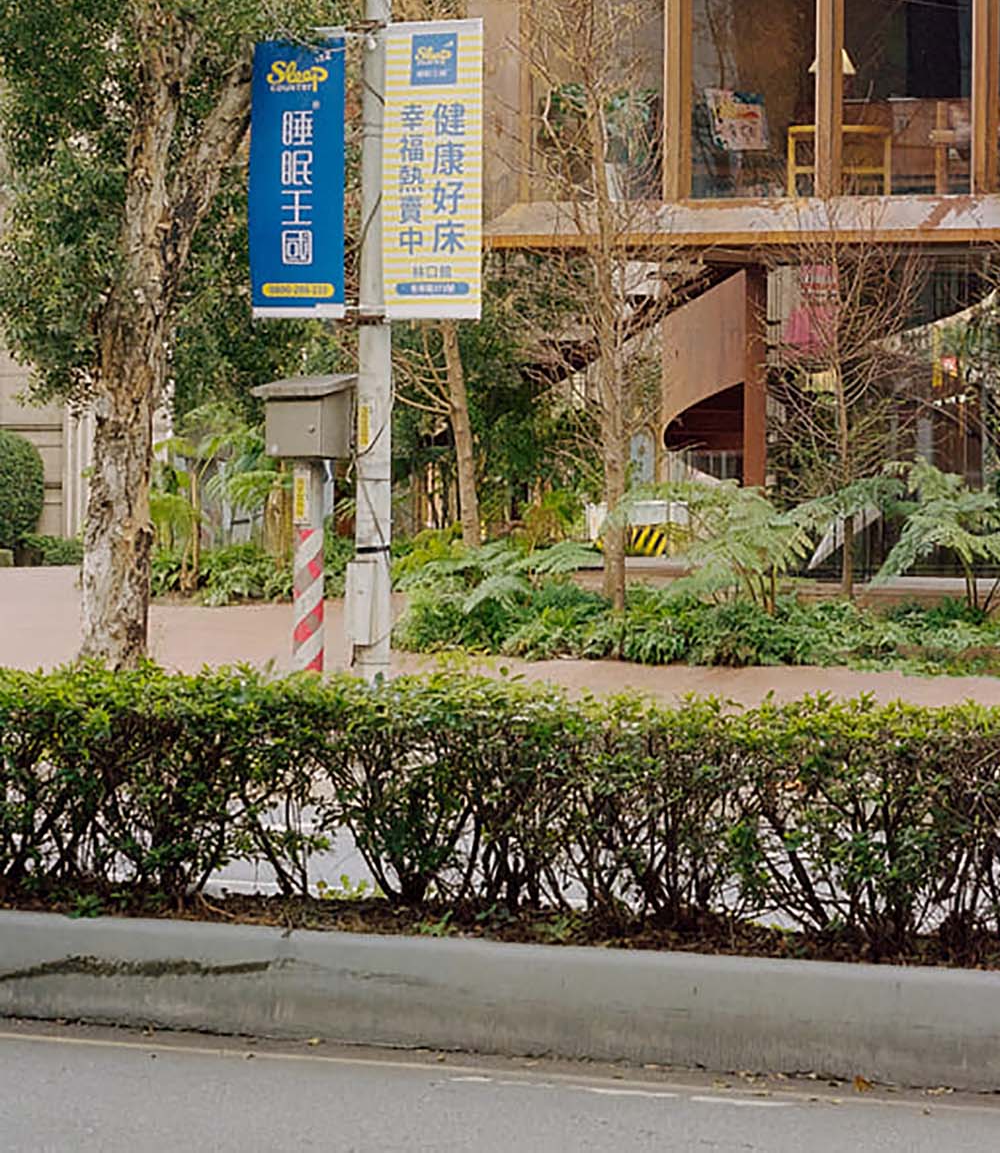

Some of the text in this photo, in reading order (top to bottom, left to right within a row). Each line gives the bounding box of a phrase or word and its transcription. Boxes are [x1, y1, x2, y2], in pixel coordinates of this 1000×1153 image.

[266, 60, 329, 93] Sleep
[280, 110, 314, 265] 睡眠王國
[398, 103, 425, 255] 幸福熱賣中
[431, 102, 466, 255] 健康好床
